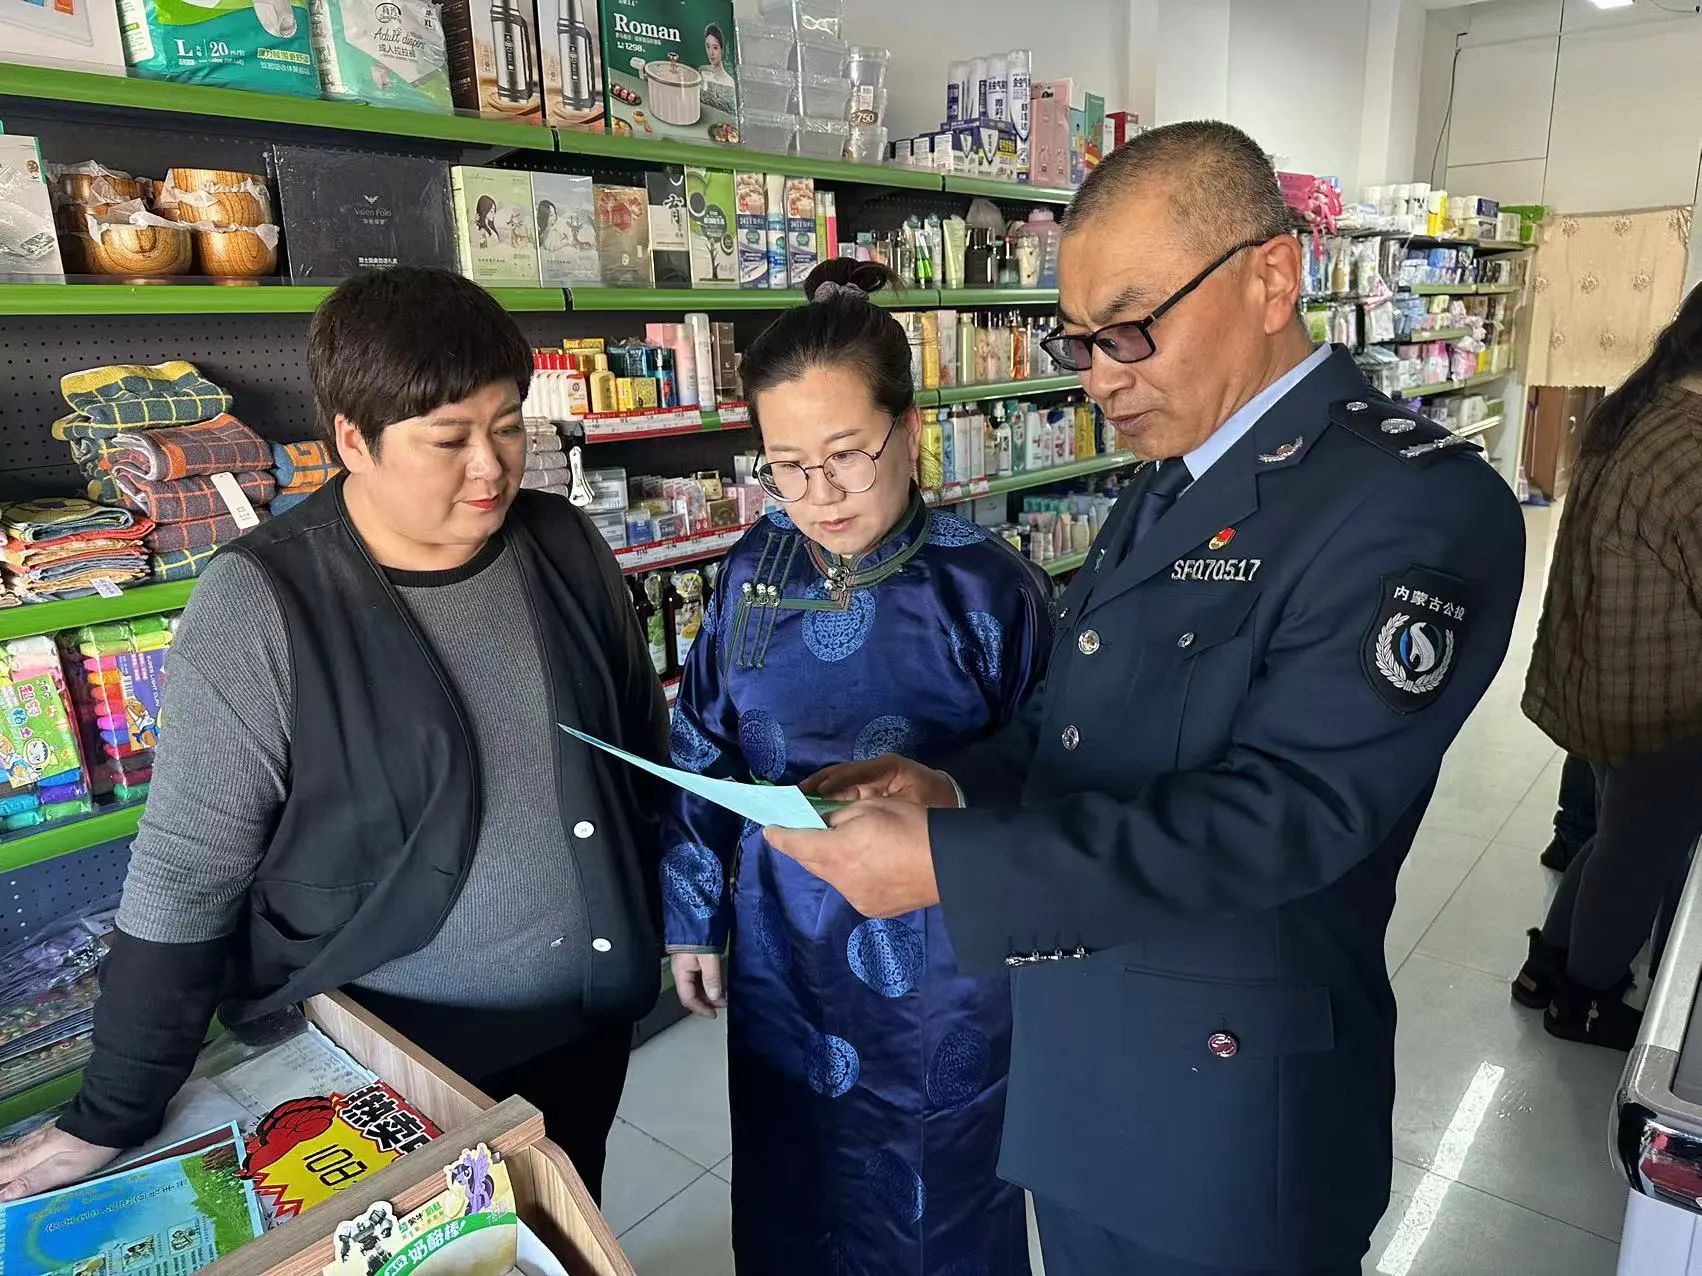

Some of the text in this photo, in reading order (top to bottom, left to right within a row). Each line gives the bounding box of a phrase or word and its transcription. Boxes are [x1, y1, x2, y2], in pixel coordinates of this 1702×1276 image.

[424, 19, 433, 28] XL
[613, 13, 682, 43] Roman
[373, 26, 402, 44] Adult
[174, 39, 194, 57] L
[210, 41, 229, 57] 20
[625, 42, 643, 52] 1298
[1394, 585, 1466, 621] 内蒙古公投
